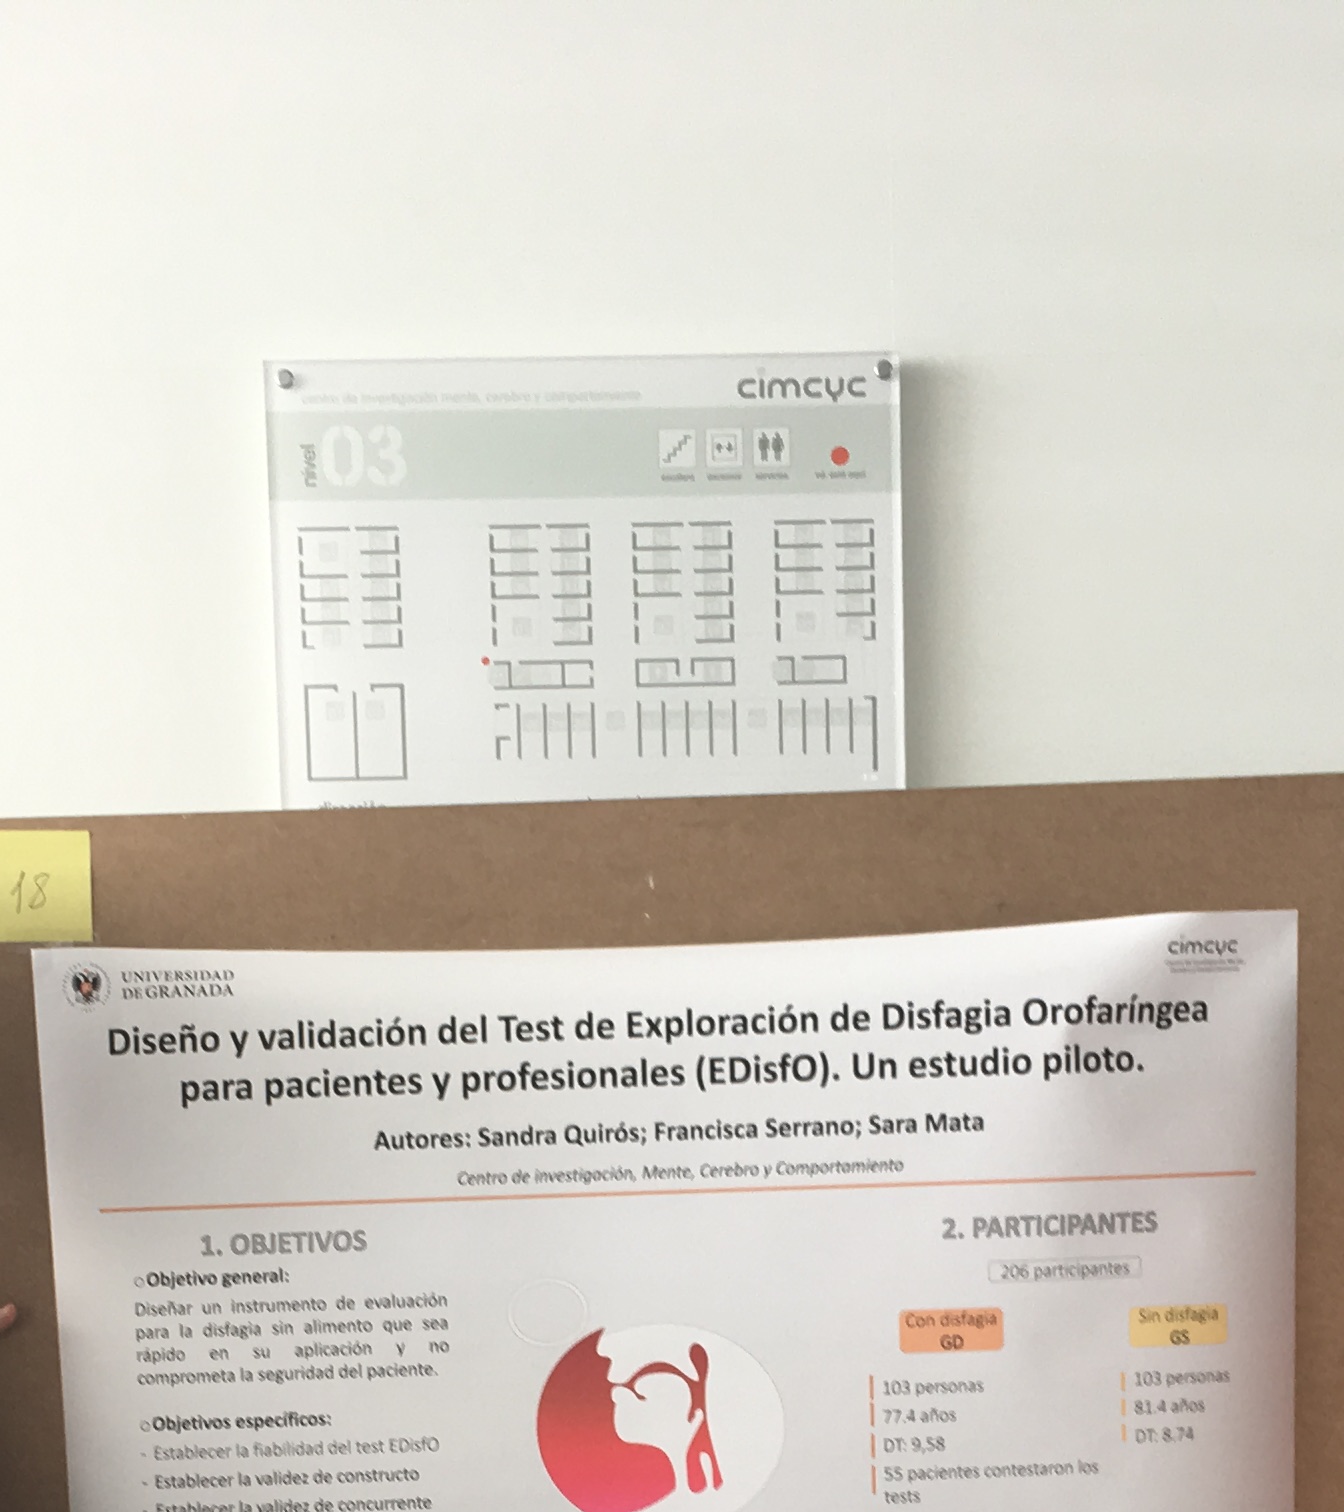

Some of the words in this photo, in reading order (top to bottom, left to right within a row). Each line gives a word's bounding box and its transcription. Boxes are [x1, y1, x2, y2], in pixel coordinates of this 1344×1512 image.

[737, 371, 866, 402] cimcyc
[321, 424, 407, 487] 03
[9, 871, 51, 914] 18
[121, 969, 235, 984] UNIVERSIDAD
[121, 987, 143, 1000] DE
[144, 983, 235, 1000] GRANADA
[108, 1024, 220, 1055] Diseño
[229, 1031, 249, 1058] y
[257, 1017, 427, 1050] validación
[437, 1015, 488, 1044] del
[497, 1016, 565, 1042] Test
[575, 1011, 615, 1040] de
[626, 1004, 819, 1045] Exploración
[830, 1003, 871, 1032] de
[882, 999, 1011, 1034] Disfagia
[1023, 995, 1208, 1030] Orofaríngea
[180, 1080, 253, 1108] para
[265, 1069, 423, 1106] pacientes
[431, 1073, 451, 1100] y
[461, 1058, 685, 1099] profesionales
[696, 1052, 840, 1091] (EDisfO).
[852, 1052, 897, 1080] Un
[908, 1047, 1032, 1078] estudio
[1043, 1044, 1144, 1081] piloto.
[374, 1131, 471, 1150] Autores:
[478, 1125, 557, 1147] Sandra
[564, 1122, 647, 1147] Quirós;
[654, 1120, 758, 1141] Francisca
[765, 1118, 862, 1138] Serrano;
[868, 1115, 917, 1135] Sara
[925, 1113, 984, 1133] Mata
[457, 1171, 508, 1185] Centro
[511, 1169, 530, 1184] de
[642, 1165, 695, 1180] Mente,
[700, 1162, 759, 1178] Cerebro
[763, 1165, 772, 1179] y
[776, 1158, 904, 1177] Comportamiento
[942, 1216, 965, 1240] 2.
[974, 1210, 1157, 1239] PARTICIPANTES
[201, 1234, 223, 1258] 1.
[231, 1230, 366, 1255] OBJETIVOS
[147, 1271, 217, 1290] Objetivo
[222, 1268, 289, 1288] general:
[1002, 1264, 1029, 1280] 206
[1034, 1262, 1130, 1282] participantes
[135, 1301, 193, 1317] Diseñar
[203, 1302, 222, 1315] un
[232, 1299, 327, 1314] instrumento
[337, 1296, 355, 1310] de
[1138, 1308, 1161, 1323] Sin
[1164, 1306, 1219, 1324] disfagia
[135, 1328, 169, 1342] para
[178, 1324, 193, 1338] la
[202, 1321, 262, 1340] disfagia
[271, 1321, 294, 1336] sin
[303, 1319, 373, 1334] alimento
[382, 1319, 412, 1335] que
[422, 1318, 449, 1331] sea
[906, 1312, 935, 1328] Con
[940, 1310, 997, 1329] disfagia
[939, 1334, 966, 1350] GD
[1169, 1330, 1191, 1346] GS
[883, 1380, 911, 1395] 103
[914, 1381, 984, 1397] personas
[1136, 1371, 1161, 1386] 103
[1166, 1371, 1230, 1387] personas
[882, 1409, 916, 1424] 77.4
[919, 1407, 957, 1423] años
[1170, 1398, 1208, 1414] años
[153, 1415, 230, 1434] Objetivos
[155, 1474, 233, 1489] Establecer
[238, 1473, 251, 1486] la
[255, 1470, 309, 1486] validez
[313, 1469, 332, 1484] de
[337, 1468, 419, 1483] constructo
